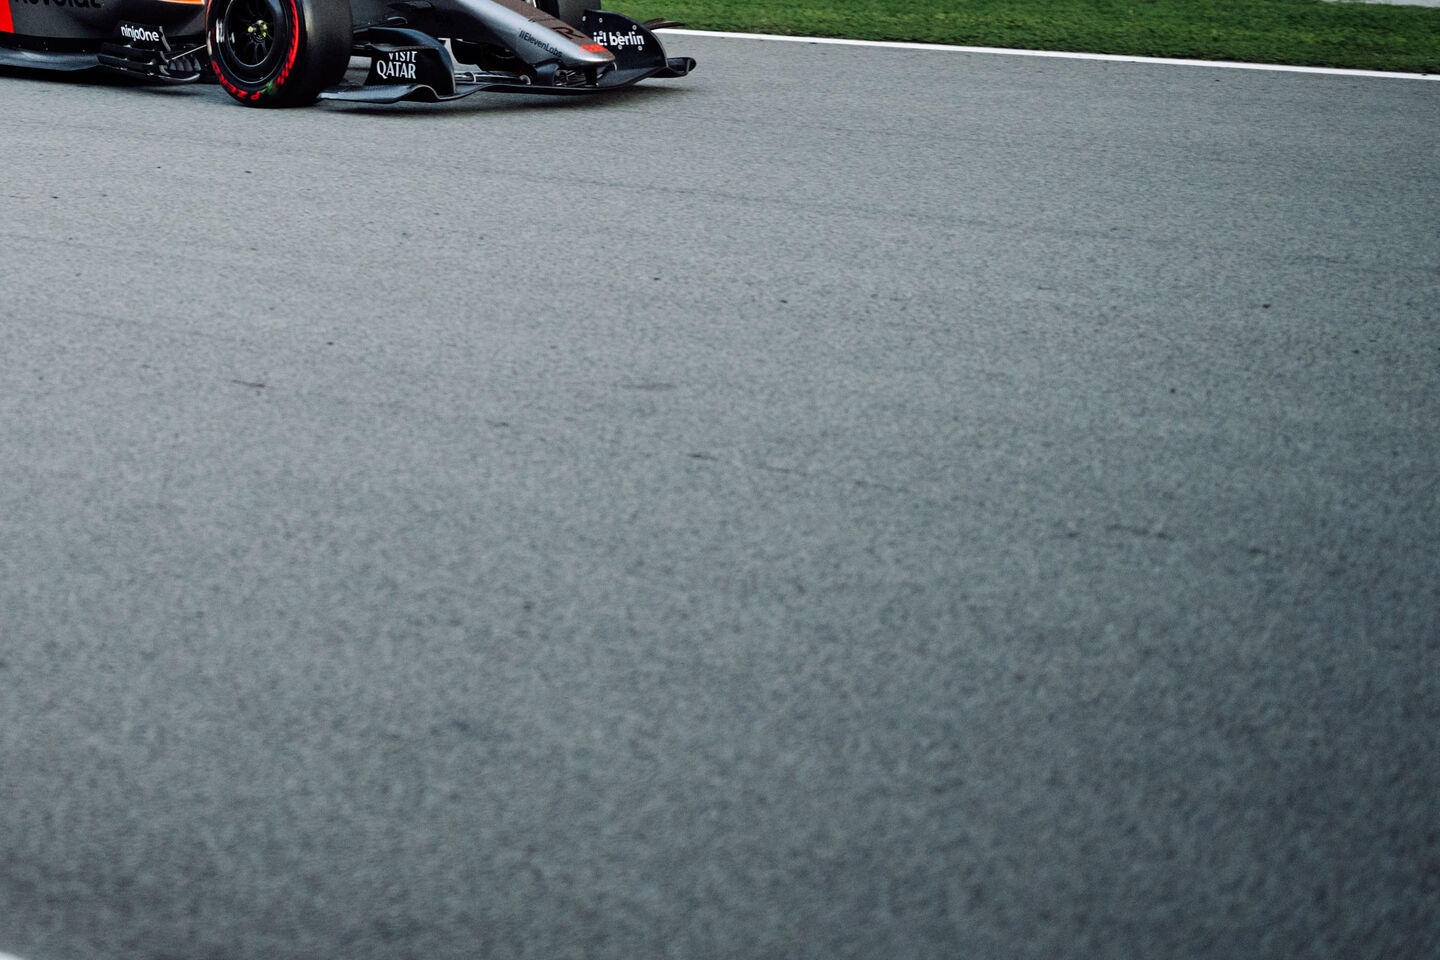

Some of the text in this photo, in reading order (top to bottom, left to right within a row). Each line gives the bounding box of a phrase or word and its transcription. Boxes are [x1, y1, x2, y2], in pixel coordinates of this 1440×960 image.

[610, 31, 645, 47] berlin
[388, 51, 418, 63] VISIT
[376, 59, 417, 80] QATAR
